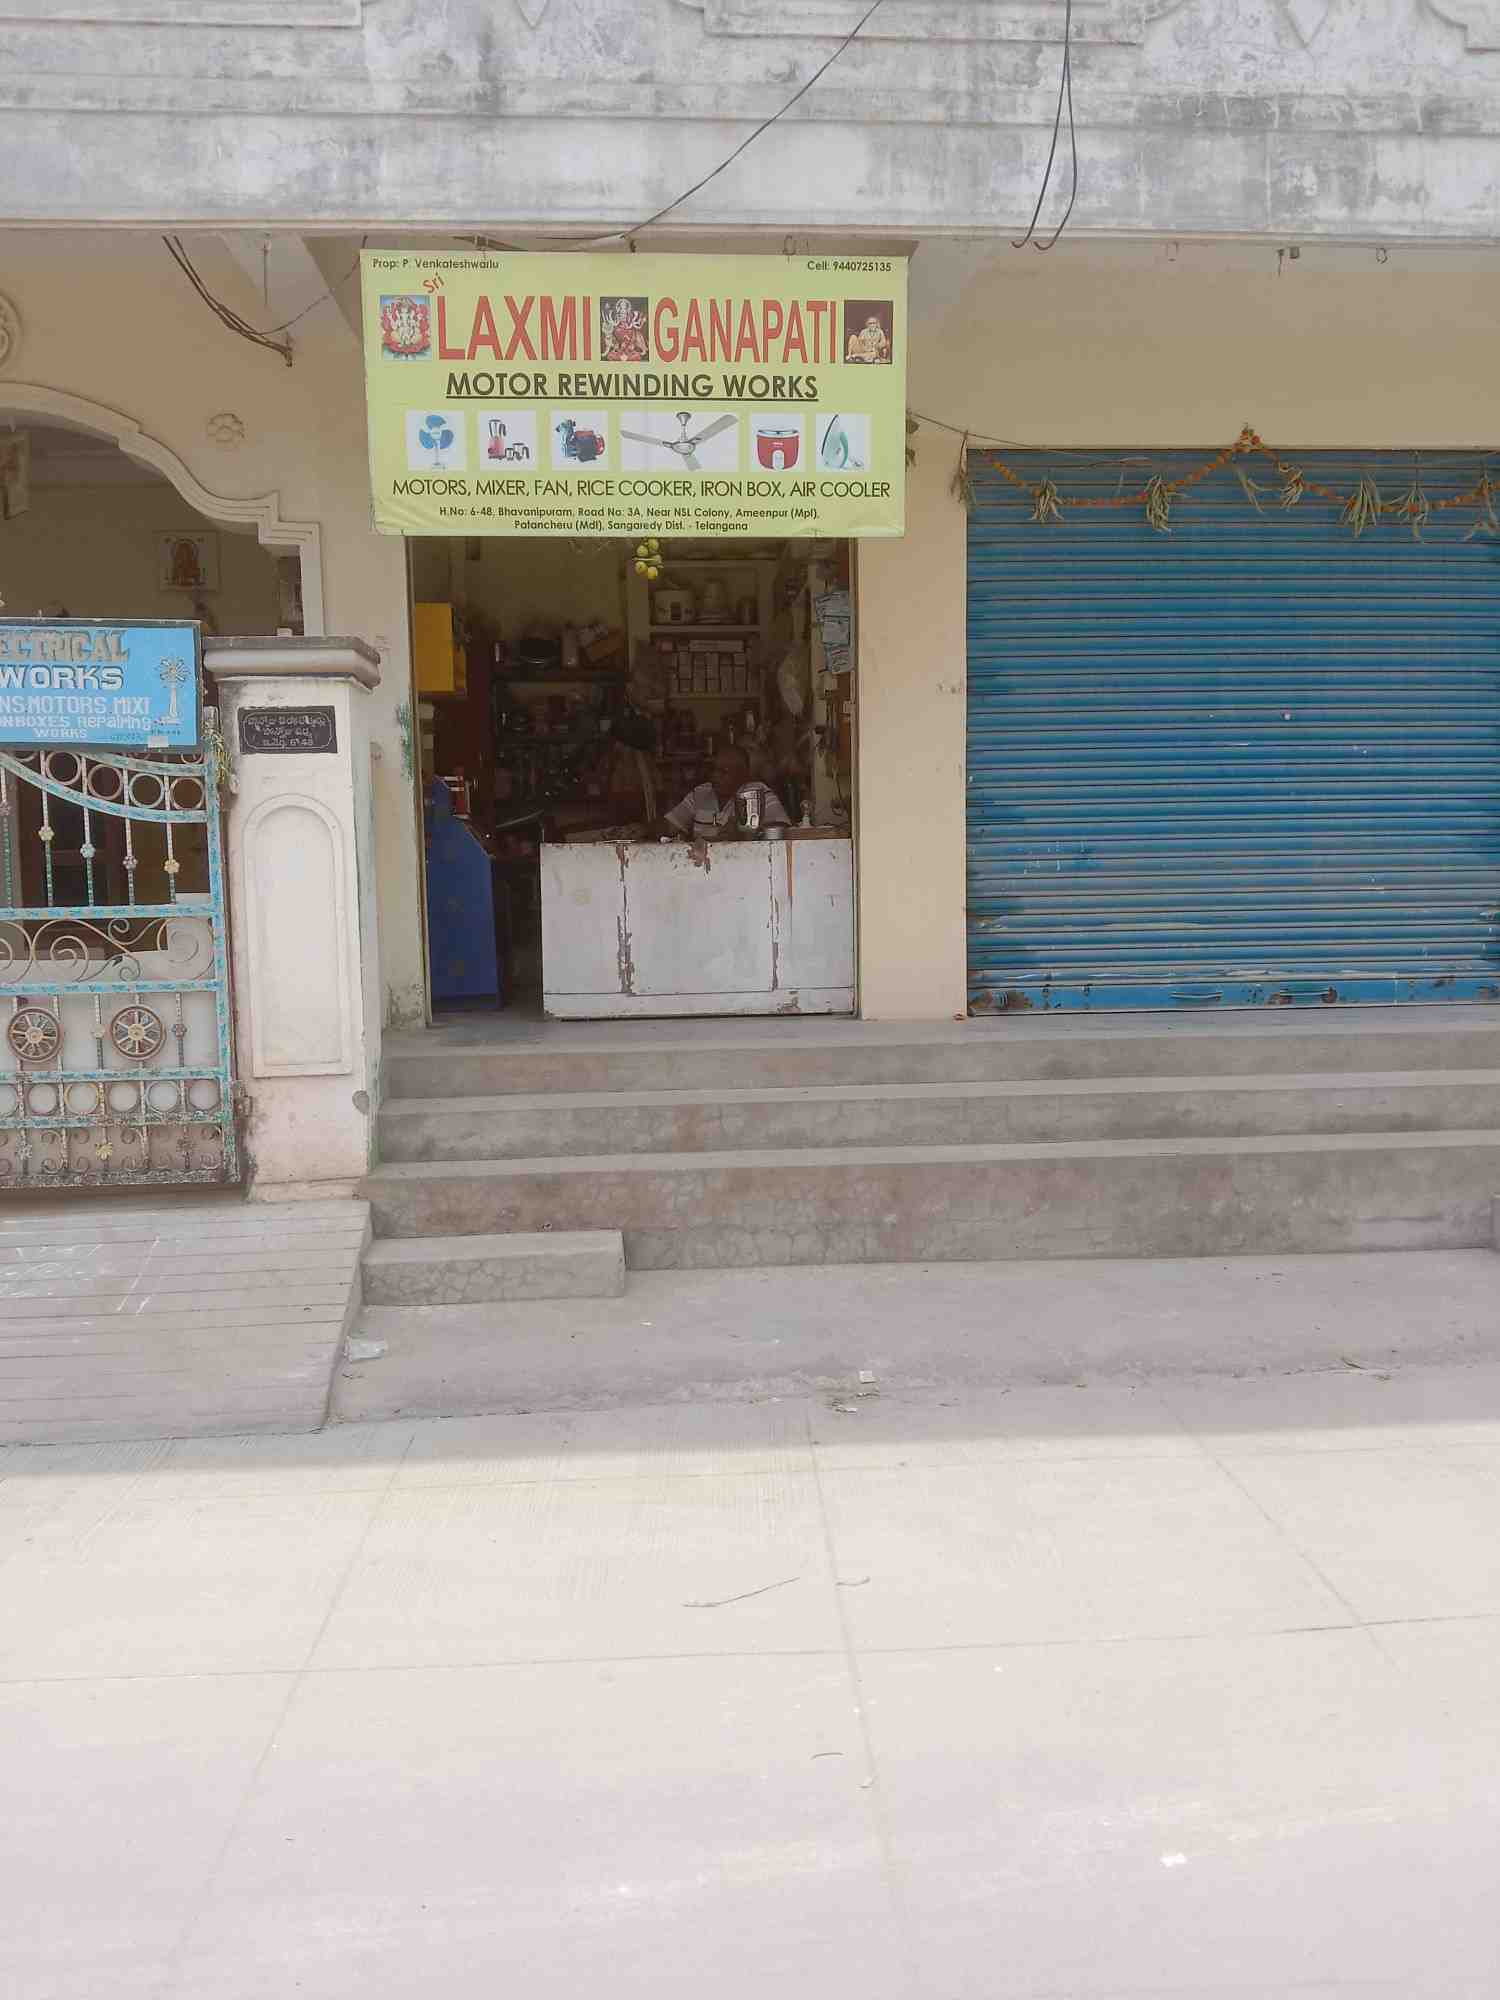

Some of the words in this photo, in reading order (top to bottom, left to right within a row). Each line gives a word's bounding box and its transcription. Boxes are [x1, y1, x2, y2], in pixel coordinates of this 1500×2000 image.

[372, 258, 400, 270] Prop:
[807, 260, 831, 271] Cell:
[832, 261, 892, 272] 9440725135
[422, 271, 445, 294] Sri
[437, 295, 592, 361] LAXMI
[654, 297, 837, 364] GANAPATI
[447, 372, 548, 396] MOTOR
[558, 373, 714, 397] REWINDING
[722, 374, 819, 399] WORKS
[392, 479, 471, 496] MOTORS,
[475, 479, 530, 497] MIXER,
[534, 480, 573, 497] FAN,
[577, 480, 614, 497] RICE
[618, 480, 697, 498] COOKER,
[701, 481, 742, 497] IRON
[746, 481, 785, 498] BOX,
[789, 482, 816, 498] AIR
[820, 481, 891, 498] COOLER
[577, 507, 605, 517] Road
[607, 507, 624, 517] No:
[646, 507, 671, 517] Near
[674, 507, 691, 518] NSL
[735, 508, 789, 519] Ameenpur
[514, 519, 573, 529] Patancheru
[696, 520, 748, 532] Telangana
[0, 665, 124, 690] WORKS
